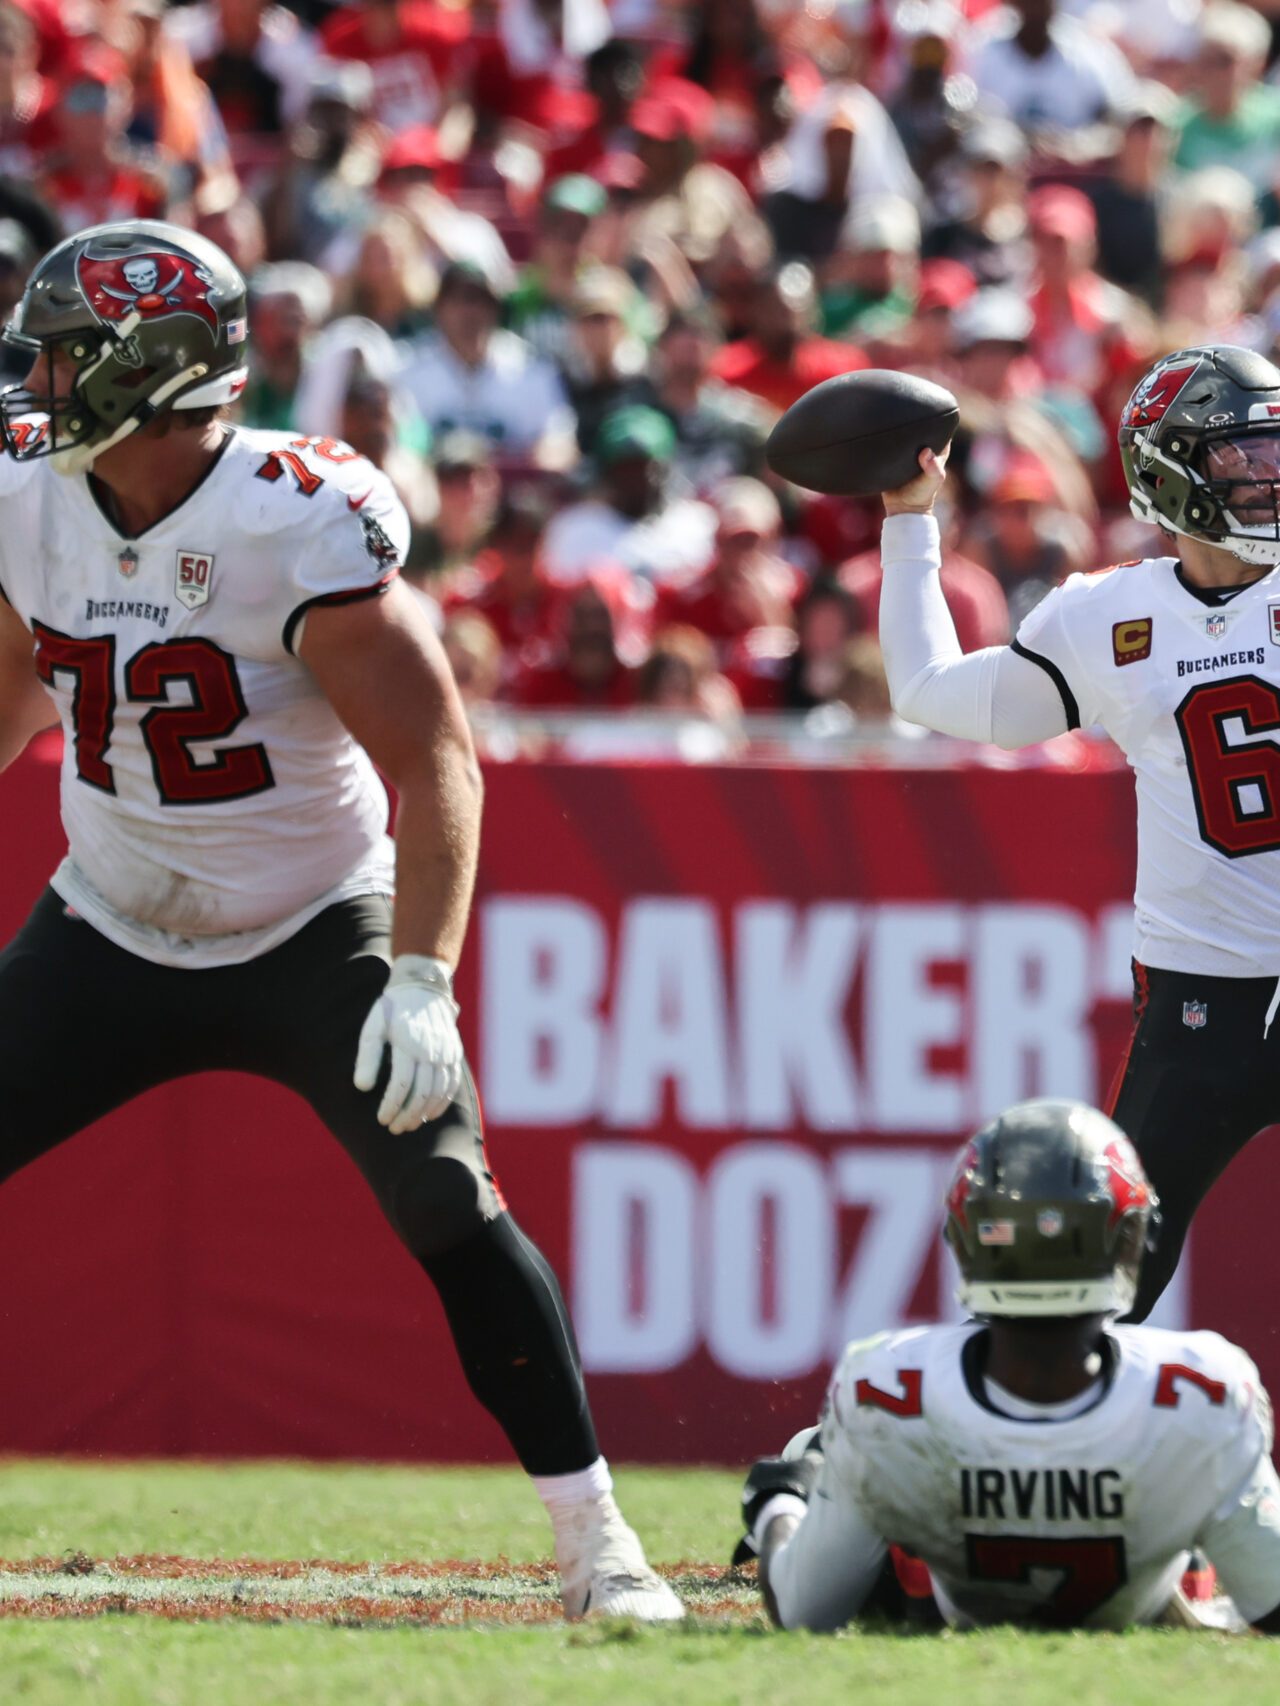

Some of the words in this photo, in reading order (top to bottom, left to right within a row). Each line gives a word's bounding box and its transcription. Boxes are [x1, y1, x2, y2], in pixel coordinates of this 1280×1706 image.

[181, 557, 208, 587] 50
[86, 599, 169, 628] BUCCANEERS
[1115, 621, 1149, 652] C
[1176, 647, 1265, 677] BUCCANEERS
[31, 617, 276, 807] 72
[855, 1369, 923, 1418] 7
[1154, 1363, 1226, 1409] 7
[960, 1467, 1124, 1520] IRVING
[964, 1533, 1129, 1630] 7
